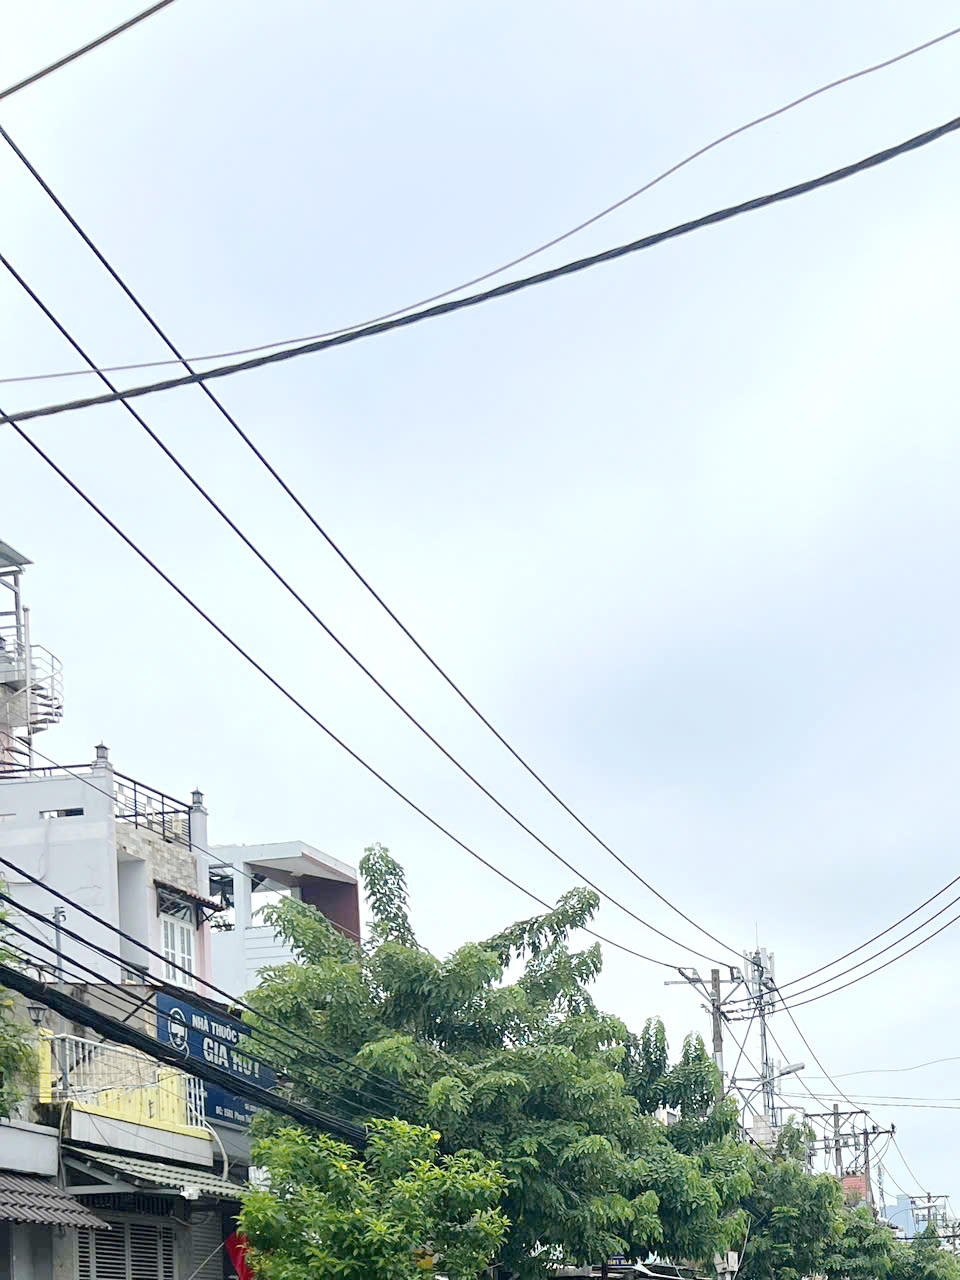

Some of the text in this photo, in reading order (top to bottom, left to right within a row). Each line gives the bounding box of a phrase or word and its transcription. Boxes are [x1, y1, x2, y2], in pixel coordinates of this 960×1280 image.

[192, 1014, 209, 1032] NHÀ
[211, 1021, 237, 1042] THUỐC
[203, 1037, 229, 1068] GIA
